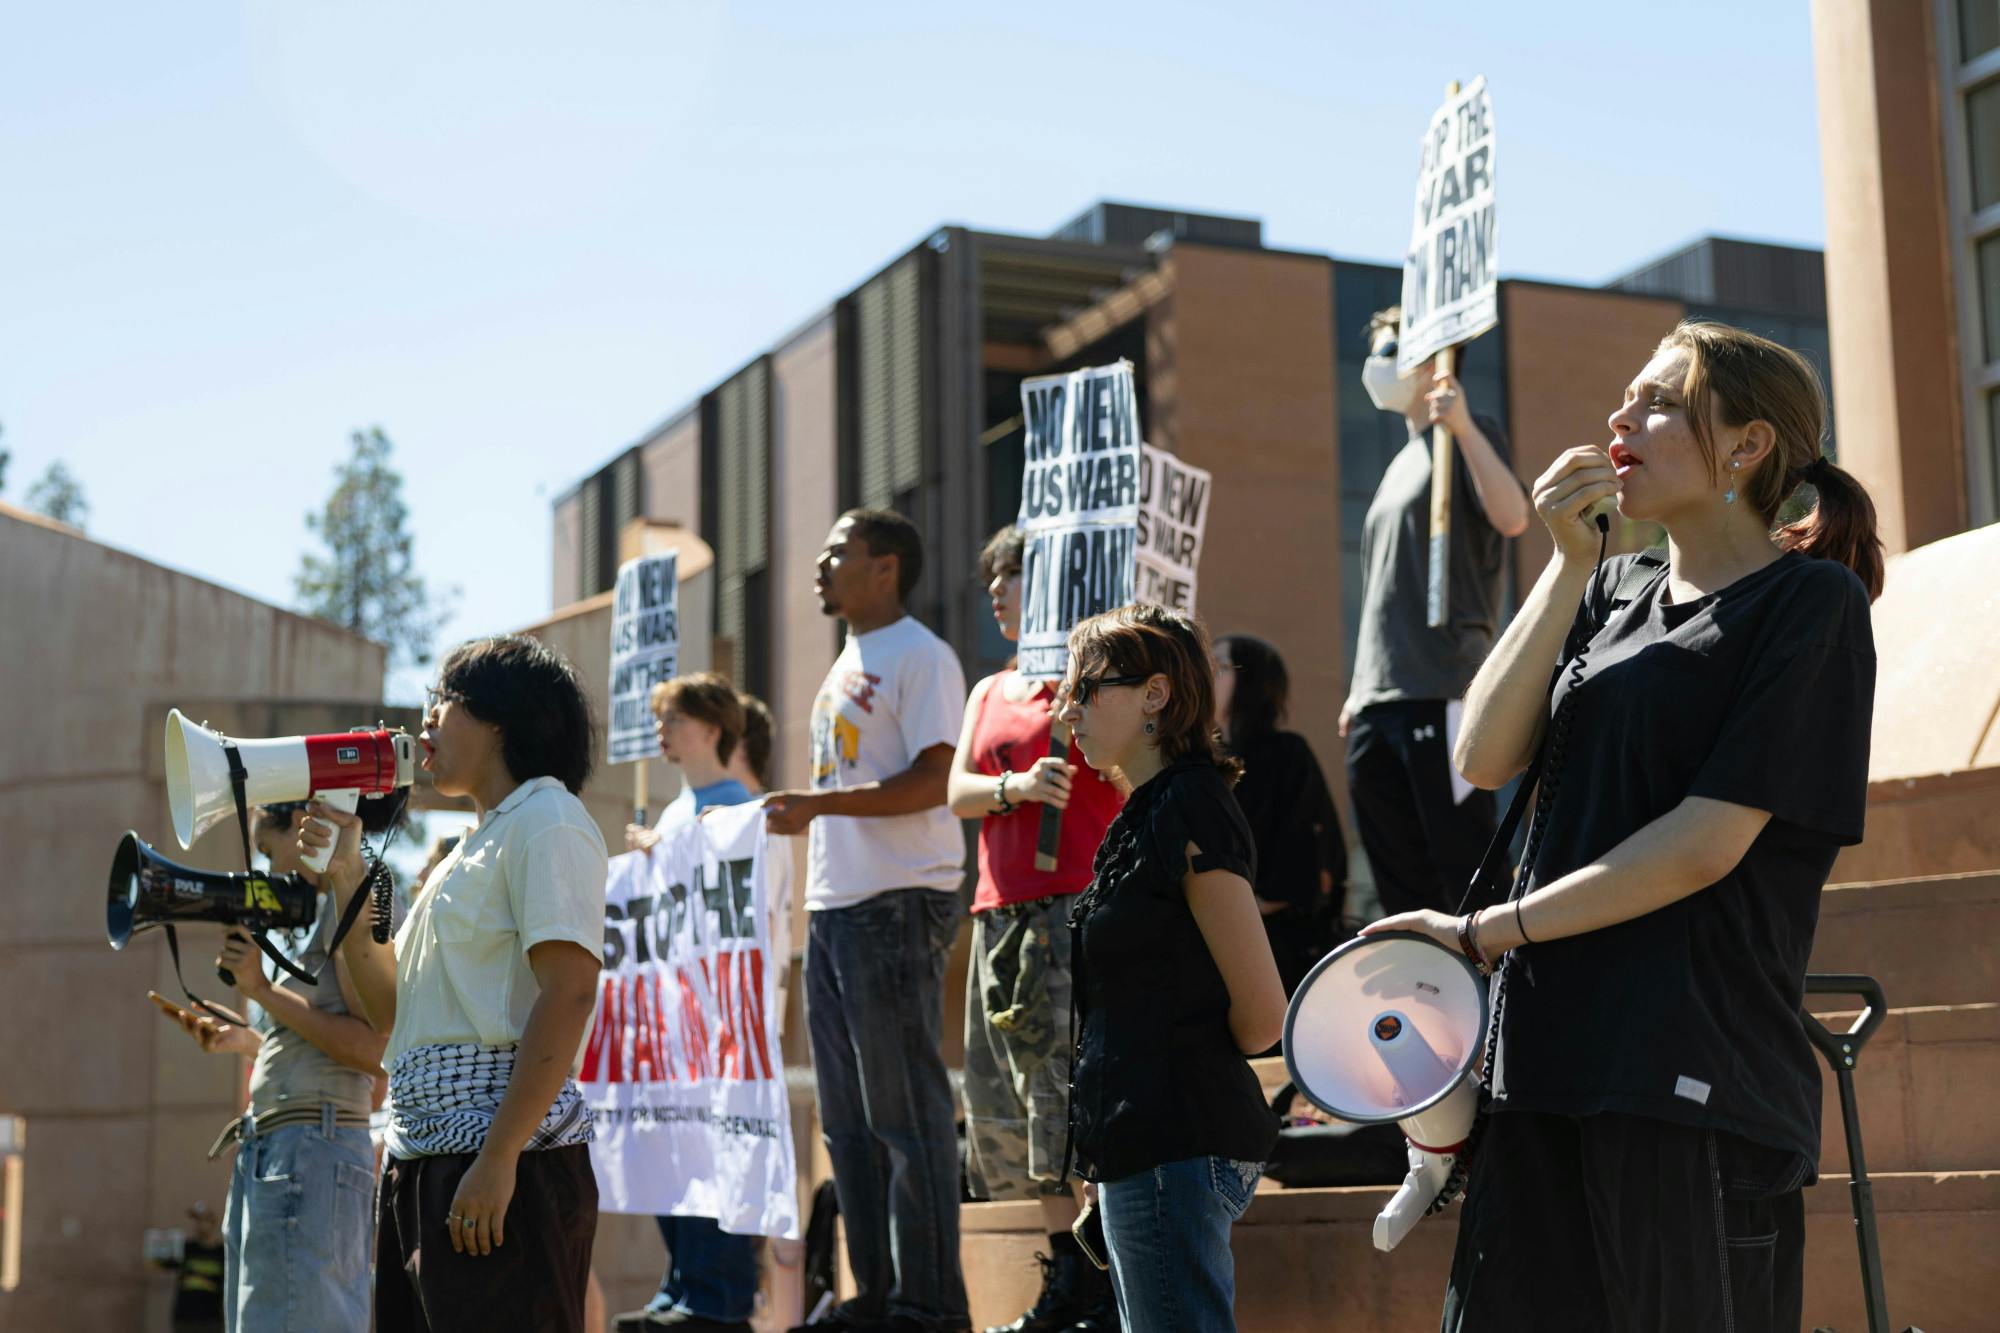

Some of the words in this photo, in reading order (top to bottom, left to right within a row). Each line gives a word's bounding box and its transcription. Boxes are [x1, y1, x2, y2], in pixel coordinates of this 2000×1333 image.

[1457, 90, 1489, 153] THE
[1434, 203, 1495, 310] IRAN
[1028, 386, 1066, 462] NO
[1072, 372, 1133, 454] NEW
[1026, 464, 1063, 518] US
[1067, 453, 1135, 512] WAR
[1139, 454, 1152, 503] O
[1159, 460, 1205, 528] NEW
[1136, 510, 1150, 547] S
[1153, 515, 1196, 569] WAR
[1024, 535, 1053, 634] ON
[1056, 525, 1135, 631] IRAN
[1147, 566, 1191, 609] THE
[634, 656, 674, 690] THE
